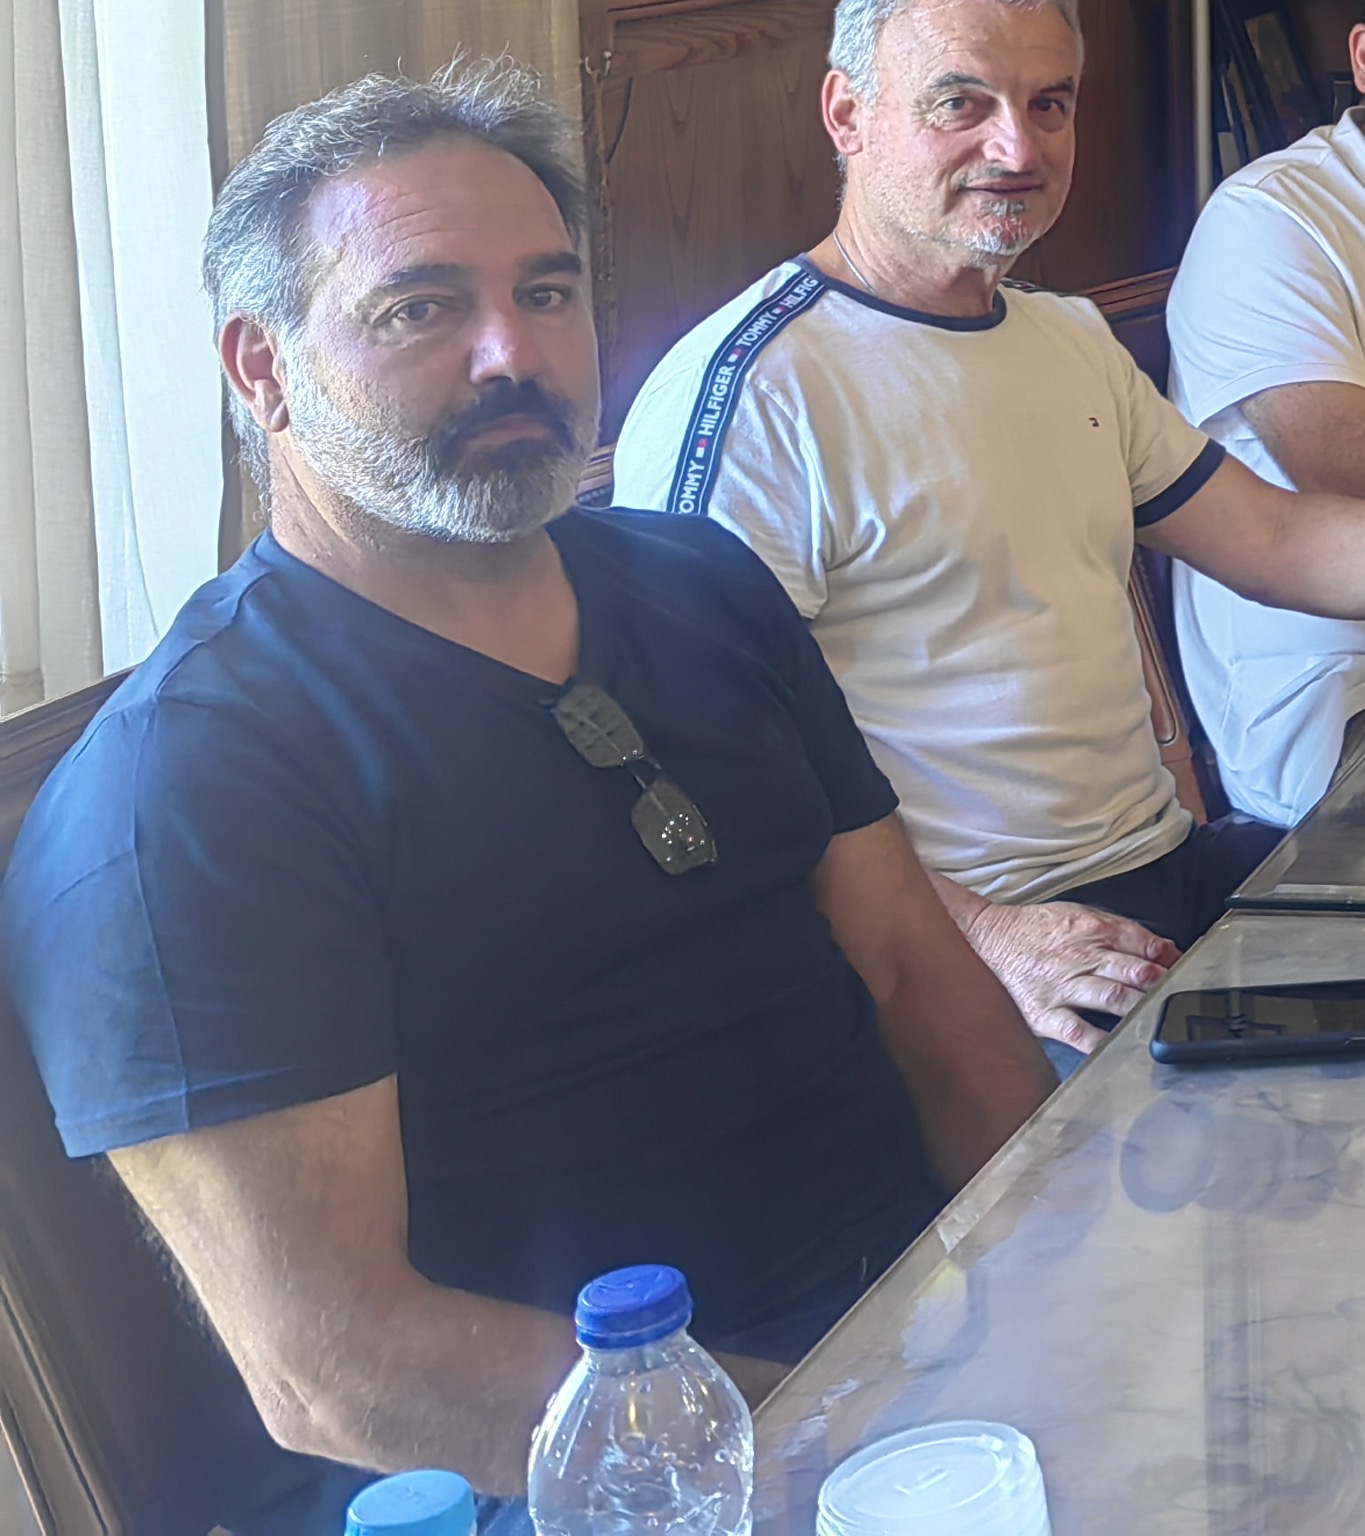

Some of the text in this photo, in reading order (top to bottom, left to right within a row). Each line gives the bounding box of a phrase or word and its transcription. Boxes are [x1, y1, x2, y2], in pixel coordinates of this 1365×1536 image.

[677, 276, 819, 515] OMMY HILFIGER TOMMY HILFIG
